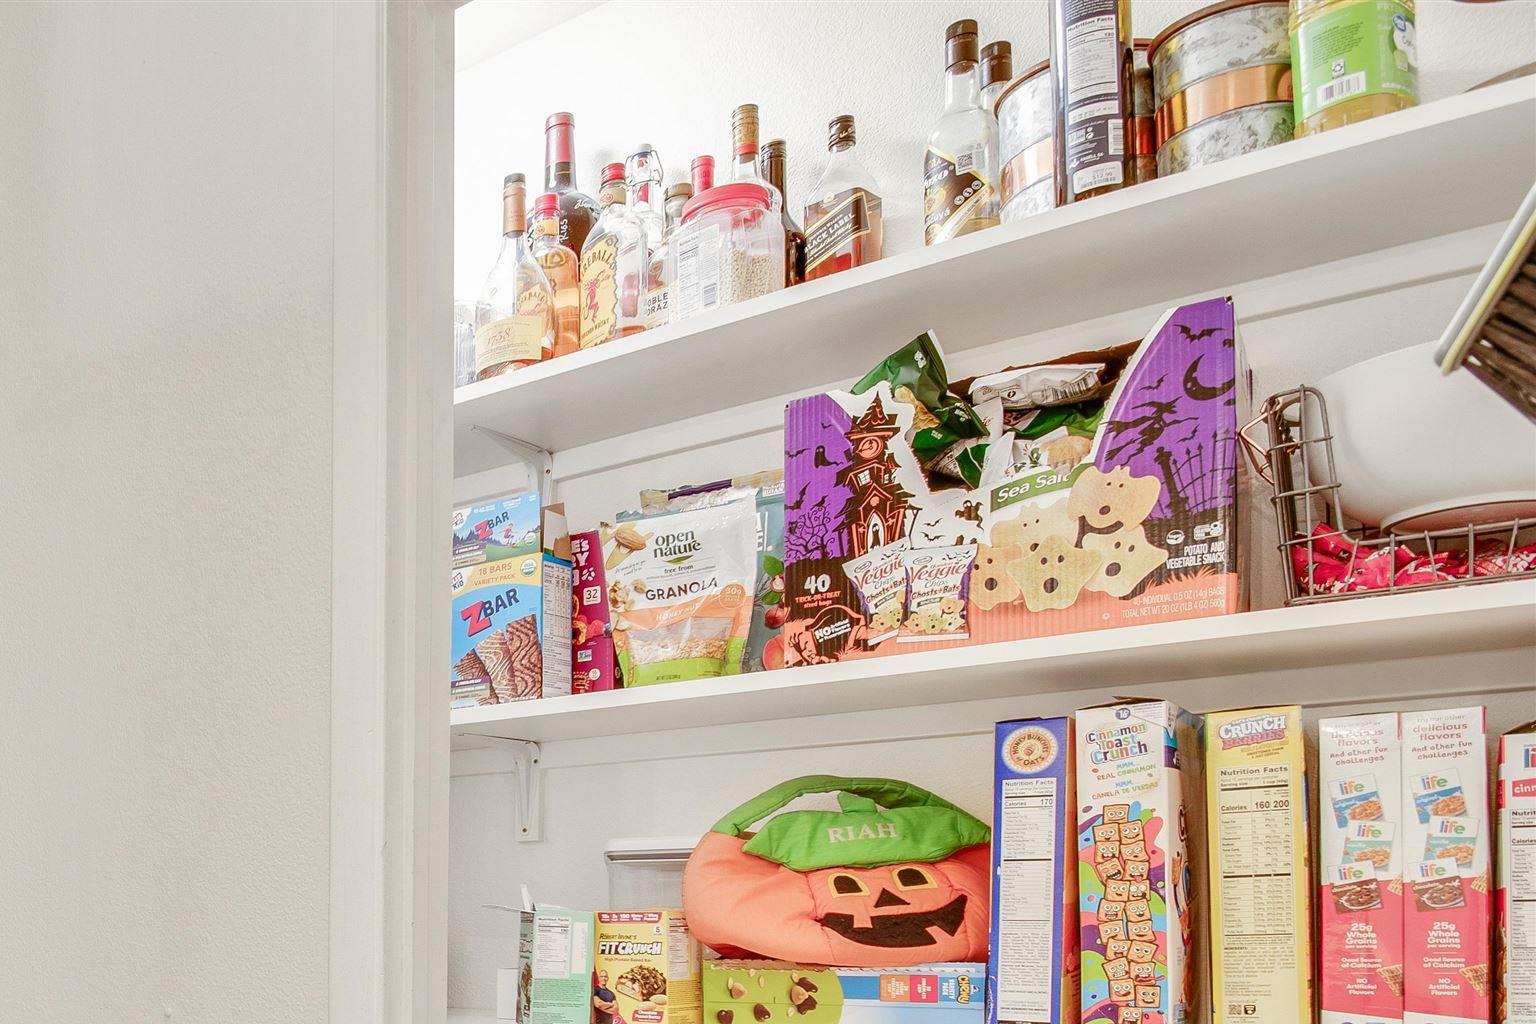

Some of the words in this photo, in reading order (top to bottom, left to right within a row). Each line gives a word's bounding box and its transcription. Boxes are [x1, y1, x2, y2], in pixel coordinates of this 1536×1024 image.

[829, 213, 855, 233] LABEL
[582, 249, 613, 276] REBALL
[997, 482, 1030, 502] Sea
[1035, 473, 1069, 490] Salt
[655, 530, 695, 549] open
[654, 539, 703, 558] nature
[1184, 543, 1208, 556] POTATO
[1210, 541, 1224, 553] AND
[1166, 555, 1202, 569] VEGETABLE
[1203, 553, 1224, 565] SNACK
[479, 567, 487, 576] 18
[490, 562, 512, 574] BARS
[854, 555, 905, 588] Veggie
[911, 560, 968, 583] Veggie
[473, 577, 498, 588] VARIETY
[500, 574, 516, 583] PACK
[804, 573, 831, 594] 40
[924, 579, 949, 589] Chips
[586, 589, 598, 600] 32
[646, 577, 718, 600] GRANOLA
[1209, 586, 1224, 596] BAGS
[1122, 608, 1138, 618] TOTAL
[1139, 606, 1151, 616] NET
[1152, 605, 1161, 614] WT
[1163, 604, 1170, 613] 20
[1171, 603, 1180, 612] OZ
[816, 626, 831, 639] NO
[1087, 723, 1146, 743] Cinnamon
[1219, 715, 1286, 739] CRUNCH
[1413, 723, 1468, 733] delicious
[1100, 734, 1137, 749] Toast
[1420, 732, 1461, 741] flavors
[1092, 741, 1148, 763] Crunch
[1348, 748, 1371, 756] other
[1430, 743, 1455, 751] other
[1024, 757, 1044, 766] OATS
[1336, 755, 1384, 765] challenges
[1418, 750, 1468, 760] challenges
[1097, 772, 1115, 781] REAL
[1221, 767, 1260, 776] Nutrition
[1339, 780, 1364, 795] life
[1421, 775, 1448, 790] life
[1255, 801, 1270, 809] 160
[1273, 800, 1289, 808] 200
[827, 823, 897, 843] RIAH
[1357, 824, 1382, 838] life
[1440, 820, 1466, 834] life
[1339, 866, 1364, 880] life
[1419, 863, 1446, 878] life
[1351, 923, 1373, 932] 25g
[1433, 922, 1456, 931] 25g
[598, 941, 662, 955] FITCRUNCH
[957, 975, 971, 1004] CHEWY
